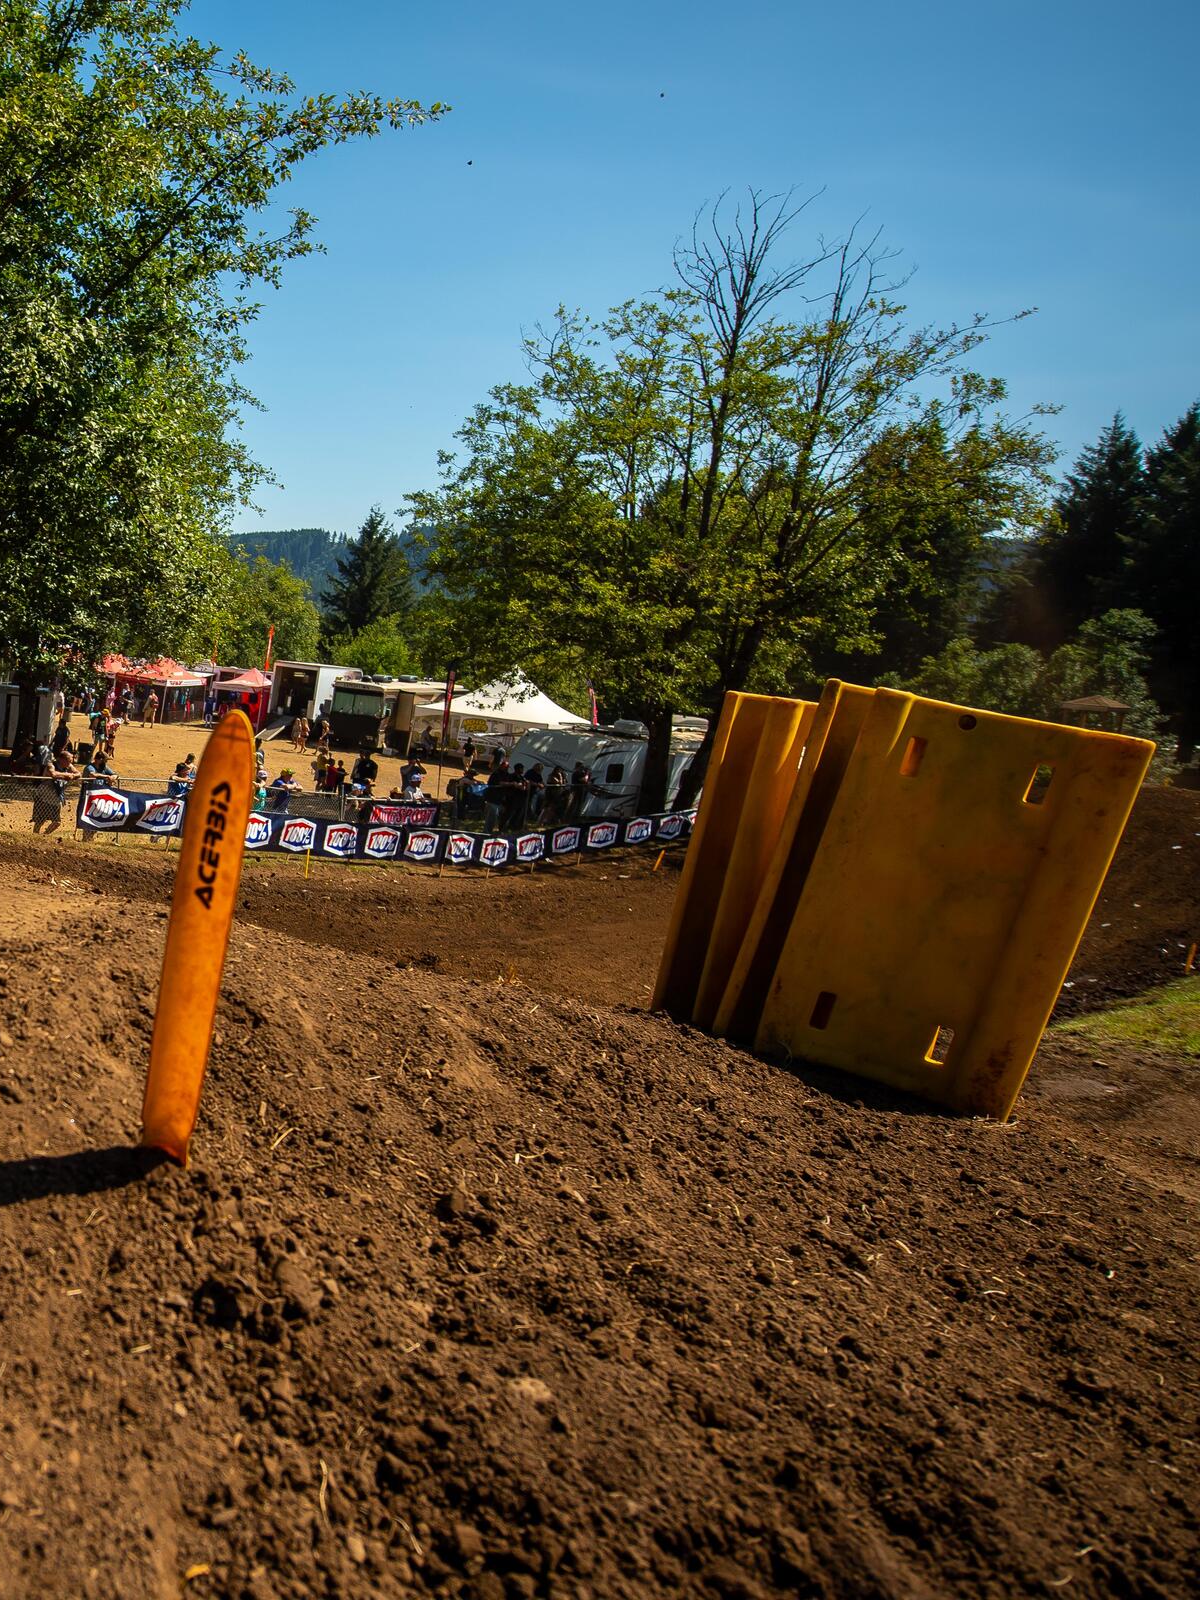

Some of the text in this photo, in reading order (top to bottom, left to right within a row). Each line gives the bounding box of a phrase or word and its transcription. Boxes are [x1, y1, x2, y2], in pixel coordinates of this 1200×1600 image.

[86, 797, 123, 820] 100%
[144, 804, 179, 824] 100%
[284, 825, 313, 845] 100%
[370, 833, 396, 854] 100%
[556, 832, 576, 850] 100%
[591, 826, 612, 843] 100%
[193, 780, 232, 911] ACERBIS
[410, 836, 433, 854] 100%
